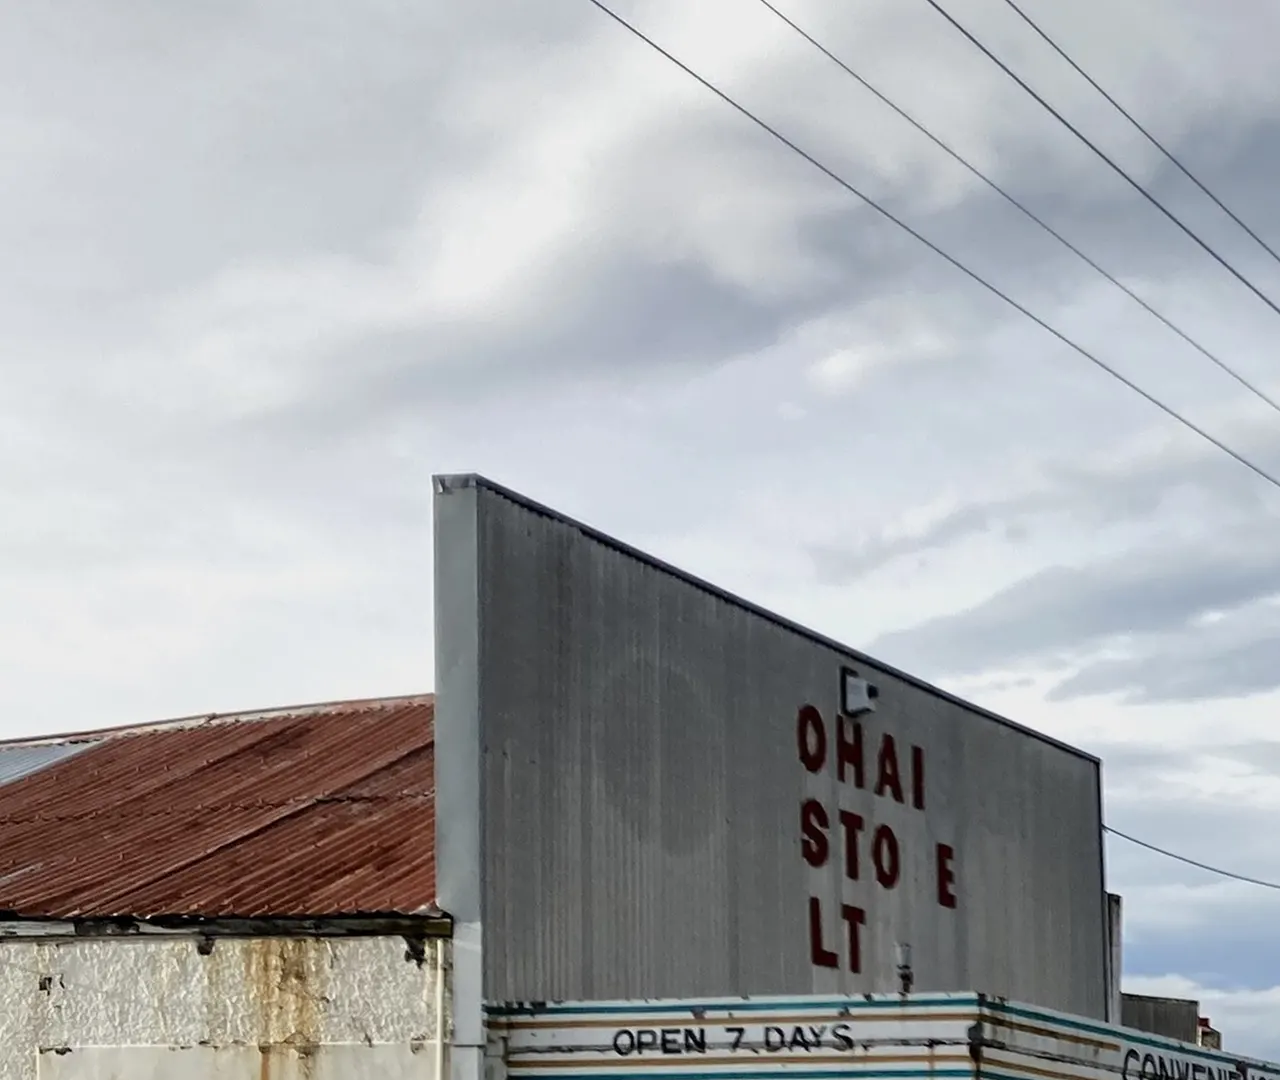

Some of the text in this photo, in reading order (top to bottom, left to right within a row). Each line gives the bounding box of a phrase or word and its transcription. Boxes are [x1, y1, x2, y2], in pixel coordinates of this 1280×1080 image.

[798, 704, 925, 811] OHAI
[801, 797, 957, 910] STOE
[613, 1028, 707, 1056] OPEN
[725, 1027, 746, 1050] 7
